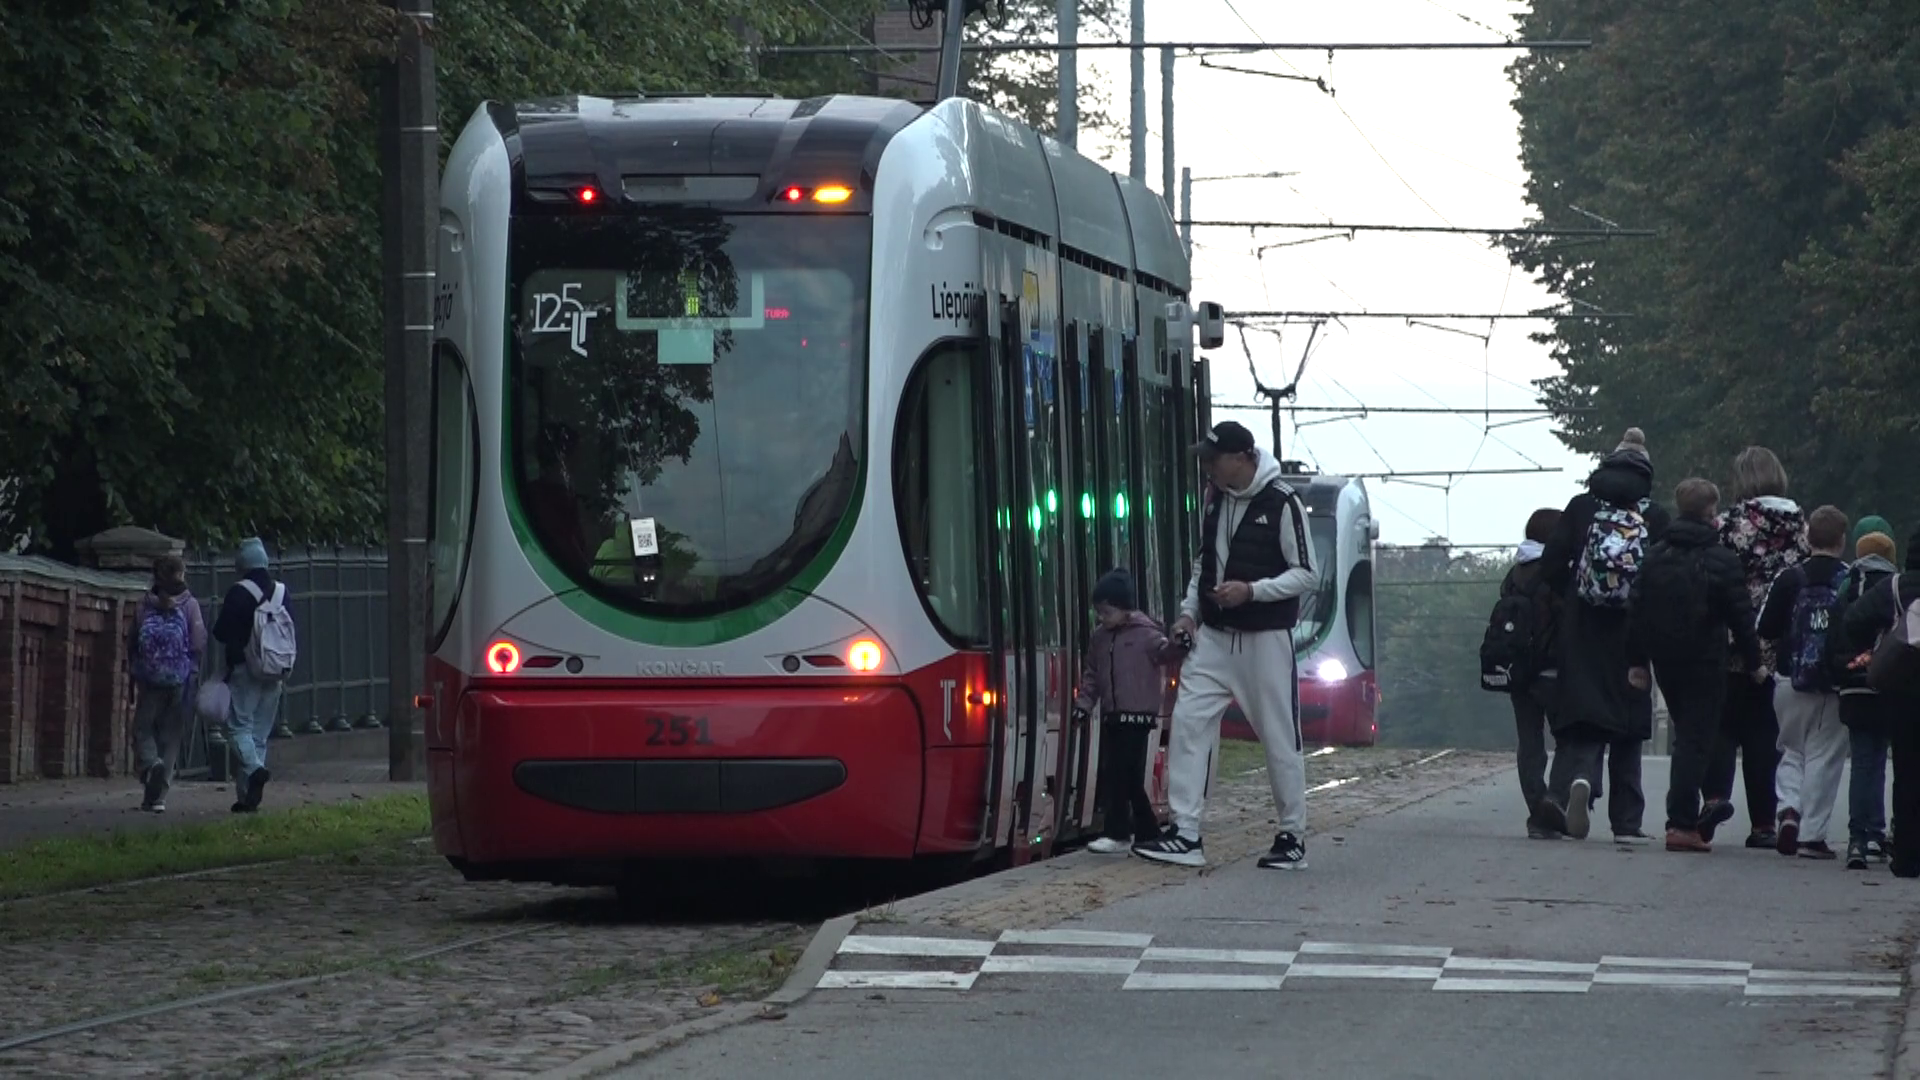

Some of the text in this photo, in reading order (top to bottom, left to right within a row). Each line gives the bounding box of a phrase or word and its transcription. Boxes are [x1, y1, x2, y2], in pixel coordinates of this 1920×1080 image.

[931, 281, 979, 328] Liepāj
[645, 715, 714, 746] 251
[1120, 713, 1152, 724] DKNY
